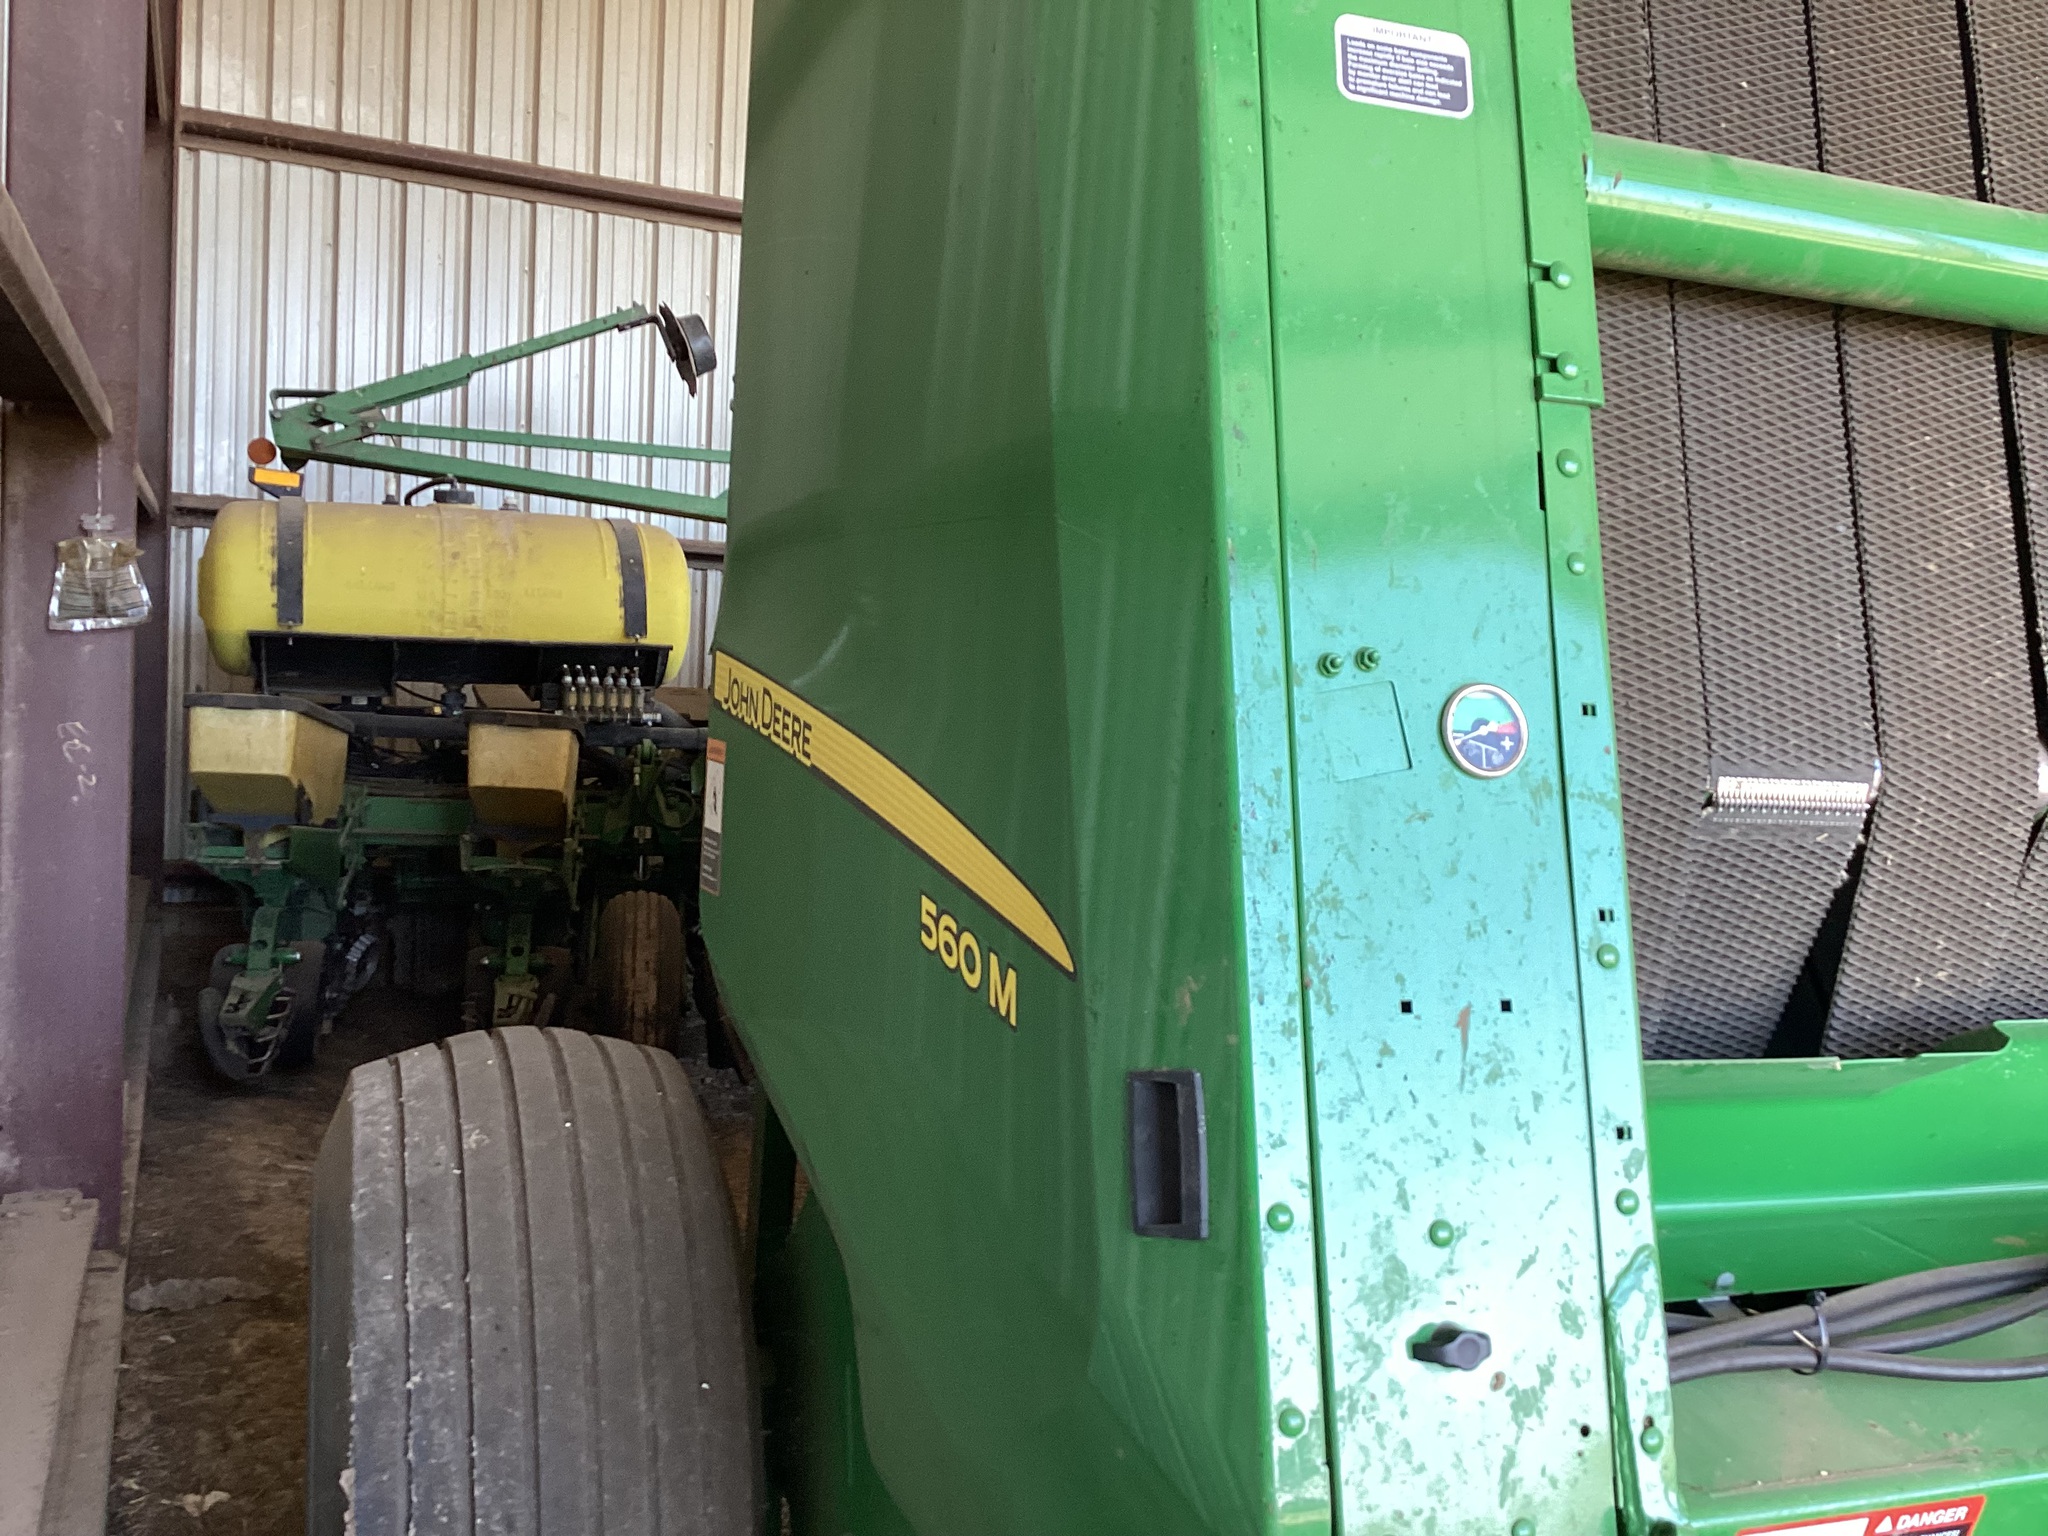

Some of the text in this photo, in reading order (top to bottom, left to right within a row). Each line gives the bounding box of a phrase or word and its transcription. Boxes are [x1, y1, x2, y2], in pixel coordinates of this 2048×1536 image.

[1373, 26, 1431, 42] IMPORTANT
[723, 667, 813, 760] JOHN DEERE
[920, 894, 1018, 1028] 560 M
[1896, 1506, 1969, 1530] DANGER
